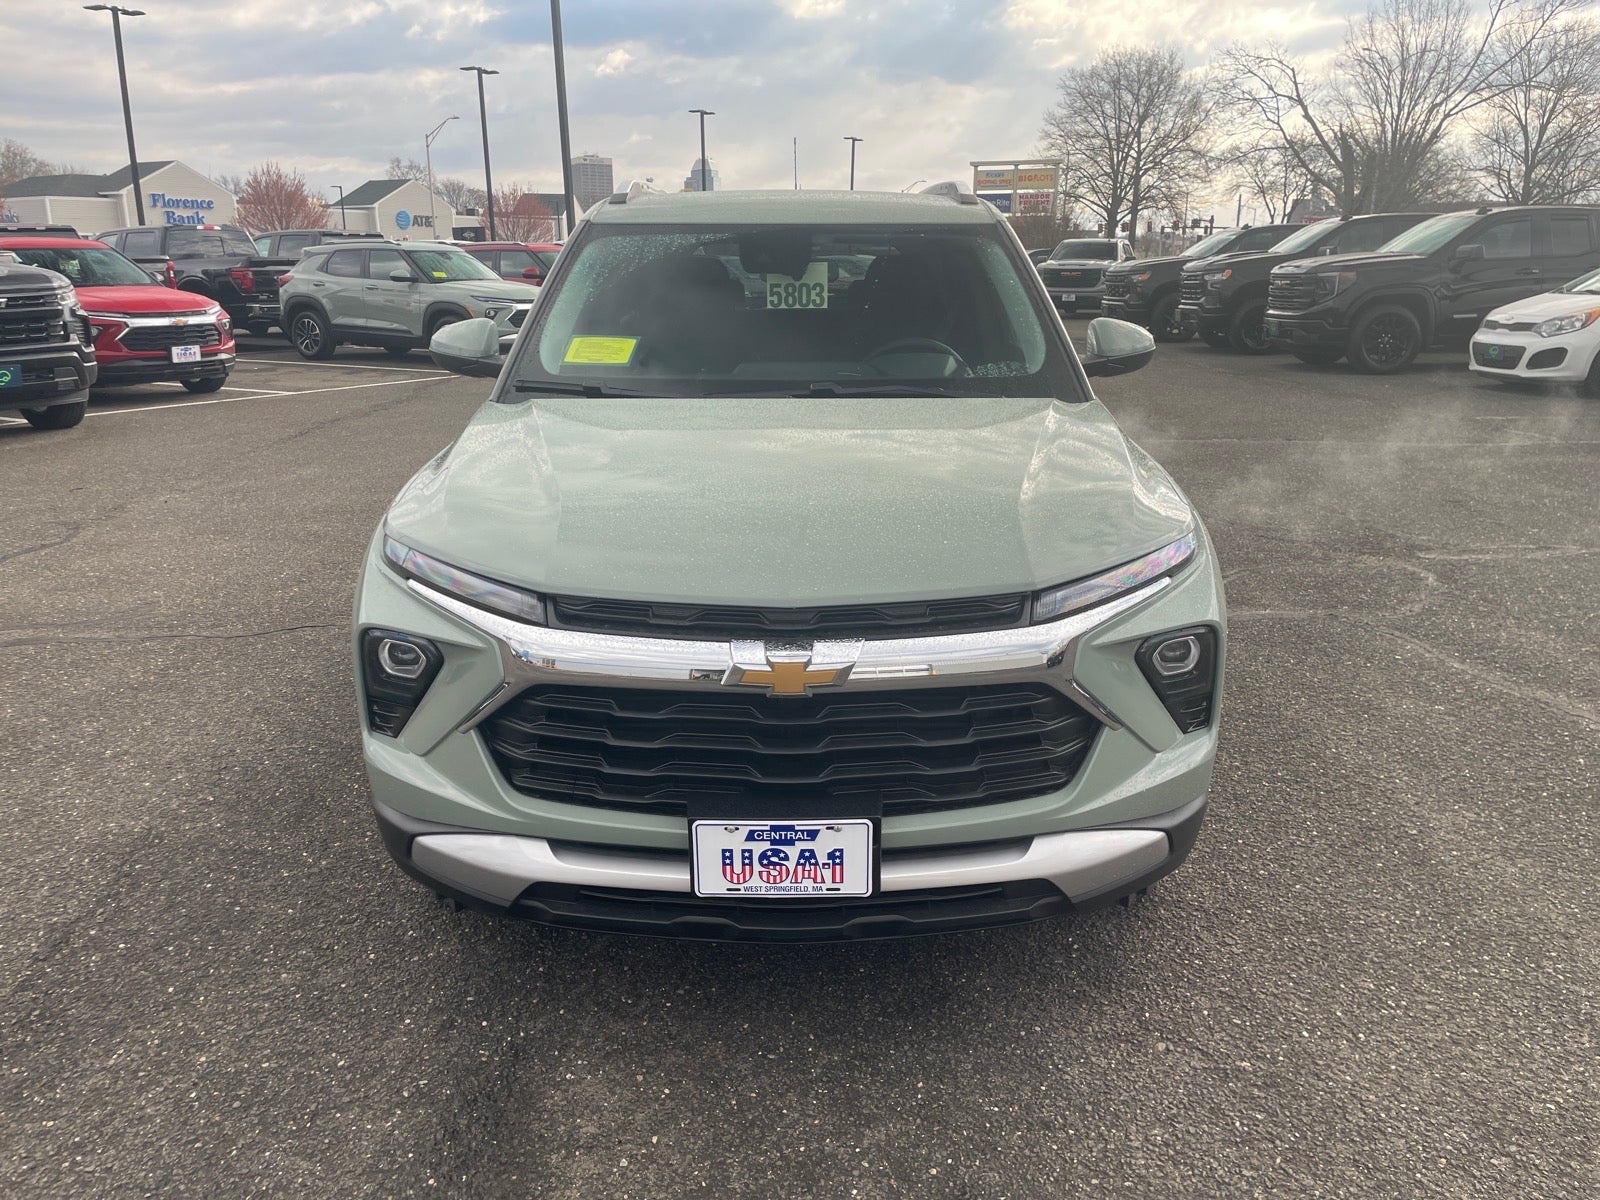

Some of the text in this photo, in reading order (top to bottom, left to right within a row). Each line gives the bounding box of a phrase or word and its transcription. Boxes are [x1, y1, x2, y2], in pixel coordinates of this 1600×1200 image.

[150, 193, 214, 209] Florence
[164, 211, 206, 225] Bank
[769, 282, 825, 308] 5803
[753, 831, 812, 841] CENTRAL
[743, 885, 763, 893] WEST
[812, 885, 824, 893] MA
